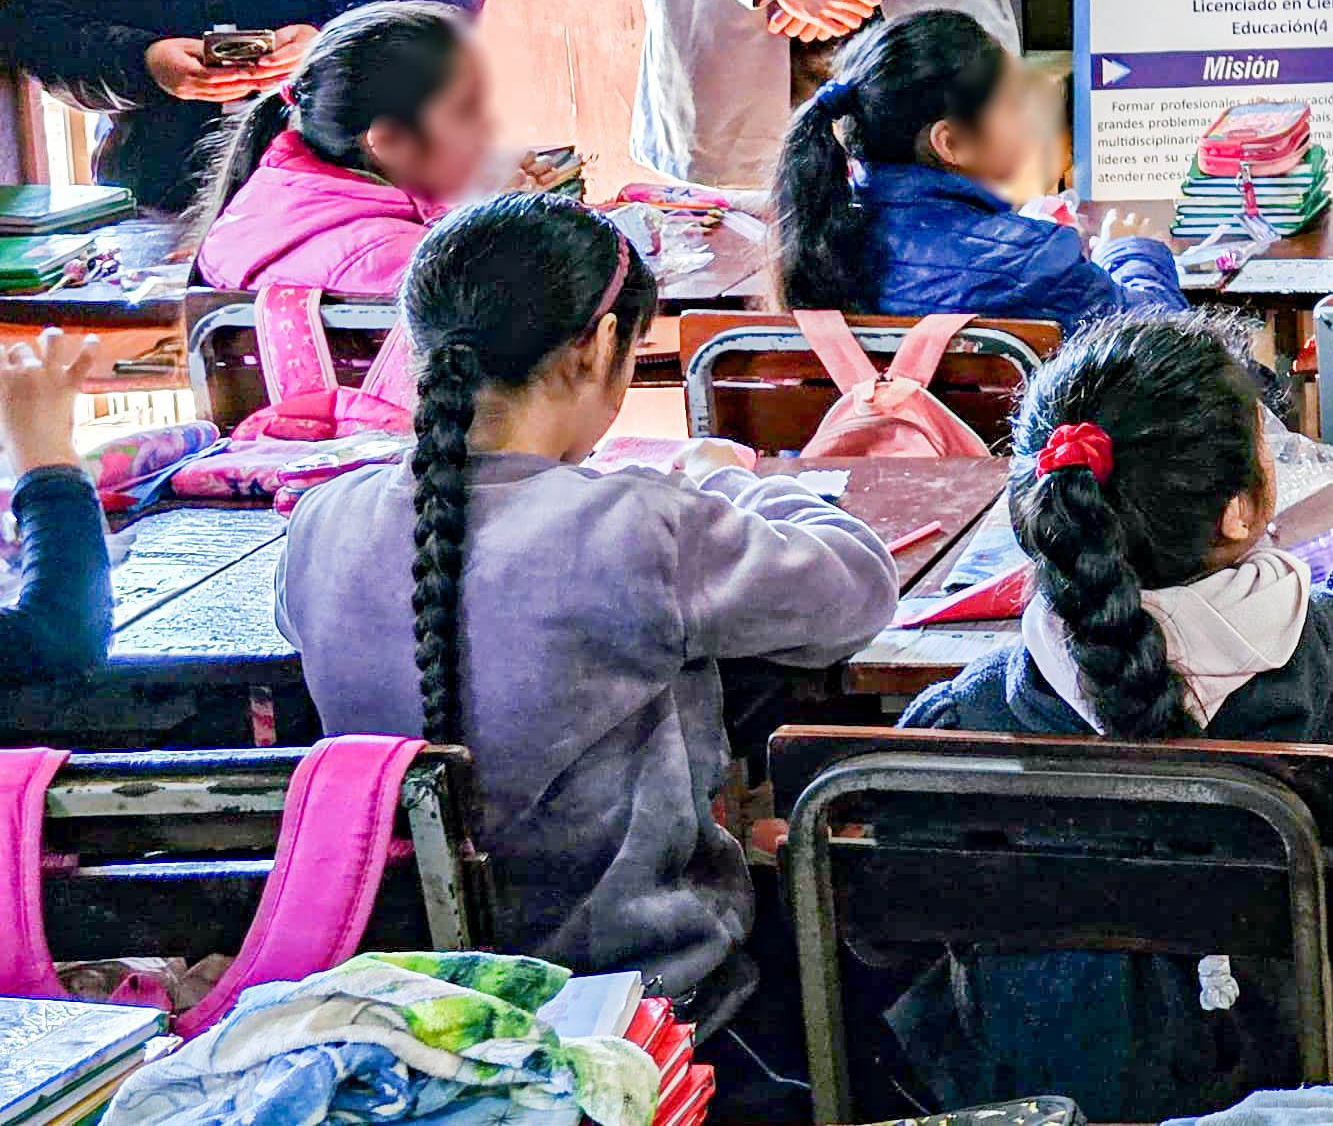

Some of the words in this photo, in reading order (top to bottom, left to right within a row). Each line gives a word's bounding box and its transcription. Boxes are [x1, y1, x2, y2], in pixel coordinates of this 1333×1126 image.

[1282, 0, 1301, 11] en
[1232, 18, 1328, 36] Educación(4
[1203, 55, 1279, 82] Misión
[1112, 101, 1154, 112] Formar
[1161, 97, 1241, 113] profesionales
[1098, 117, 1144, 131] grandes
[1149, 115, 1213, 130] problemas
[1098, 154, 1136, 165] líderes
[1144, 155, 1158, 164] en
[1165, 154, 1178, 163] su
[1098, 172, 1147, 183] atender
